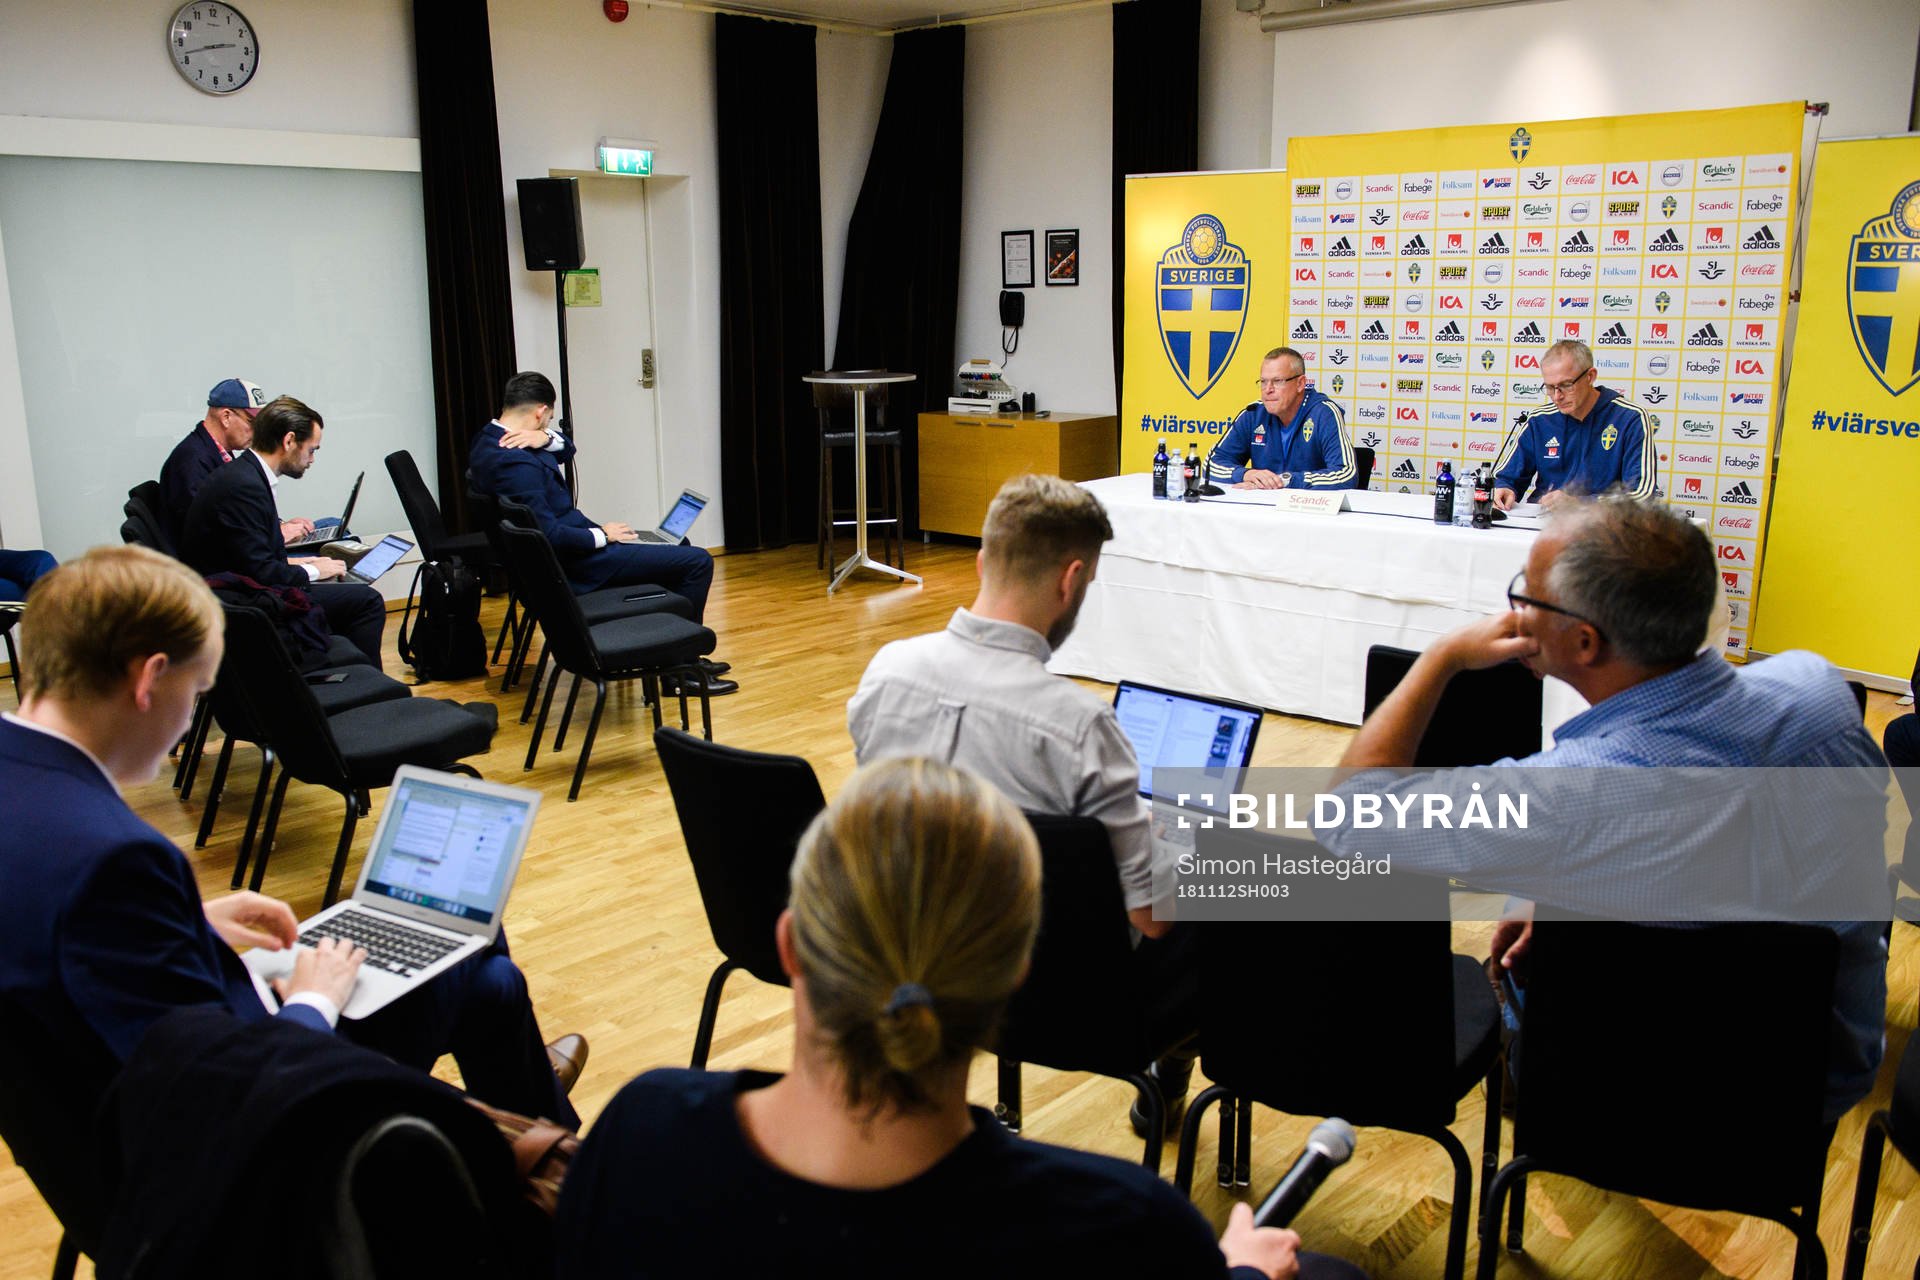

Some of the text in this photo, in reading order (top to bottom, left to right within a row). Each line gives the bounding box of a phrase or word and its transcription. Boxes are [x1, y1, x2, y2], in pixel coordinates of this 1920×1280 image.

[194, 11, 200, 20] 11
[209, 9, 217, 17] 12
[184, 22, 192, 30] 10
[239, 29, 243, 37] 2
[244, 47, 249, 55] 3
[240, 63, 244, 71] 4
[198, 70, 202, 78] 7
[213, 76, 218, 85] 6
[1612, 171, 1639, 185] ICA
[1296, 185, 1320, 194] SPORT
[1404, 183, 1432, 193] Fabege
[1609, 202, 1639, 212] SPORT
[1747, 200, 1782, 212] Fabege
[1483, 207, 1510, 216] SPORT
[1561, 244, 1593, 252] adidas
[1649, 243, 1683, 251] adidas
[1743, 240, 1780, 249] adidas
[1870, 244, 1920, 258] SVER
[1708, 261, 1717, 270] SJ
[1296, 269, 1316, 280] ICA
[1440, 267, 1467, 276] SPORT
[1561, 269, 1591, 280] Fabege
[1651, 264, 1678, 278] ICA
[1170, 270, 1235, 282] SVERIGE
[1328, 300, 1352, 309] Fabege
[1364, 296, 1389, 305] SPORT
[1440, 296, 1463, 309] ICA
[1739, 299, 1774, 310] Fabege
[1514, 335, 1545, 343] adidas
[1688, 338, 1723, 346] adidas
[1515, 355, 1539, 368] ICA
[1687, 362, 1719, 373] Fabege
[1735, 360, 1764, 374] ICA
[1398, 380, 1423, 389] SPORT
[1472, 385, 1499, 396] Fabege
[1651, 386, 1660, 394] SJ
[1359, 408, 1385, 419] Fabege
[1397, 408, 1419, 420] ICA
[1141, 415, 1232, 434] #viärsveri
[1742, 421, 1751, 429] SJ
[1812, 410, 1920, 438] #viärsve
[1679, 455, 1712, 463] Scandic
[1725, 457, 1759, 469] Fabege
[1392, 471, 1419, 479] adidas
[1289, 494, 1330, 506] Scandic
[1721, 494, 1757, 504] adidas
[1718, 545, 1745, 561] ICA
